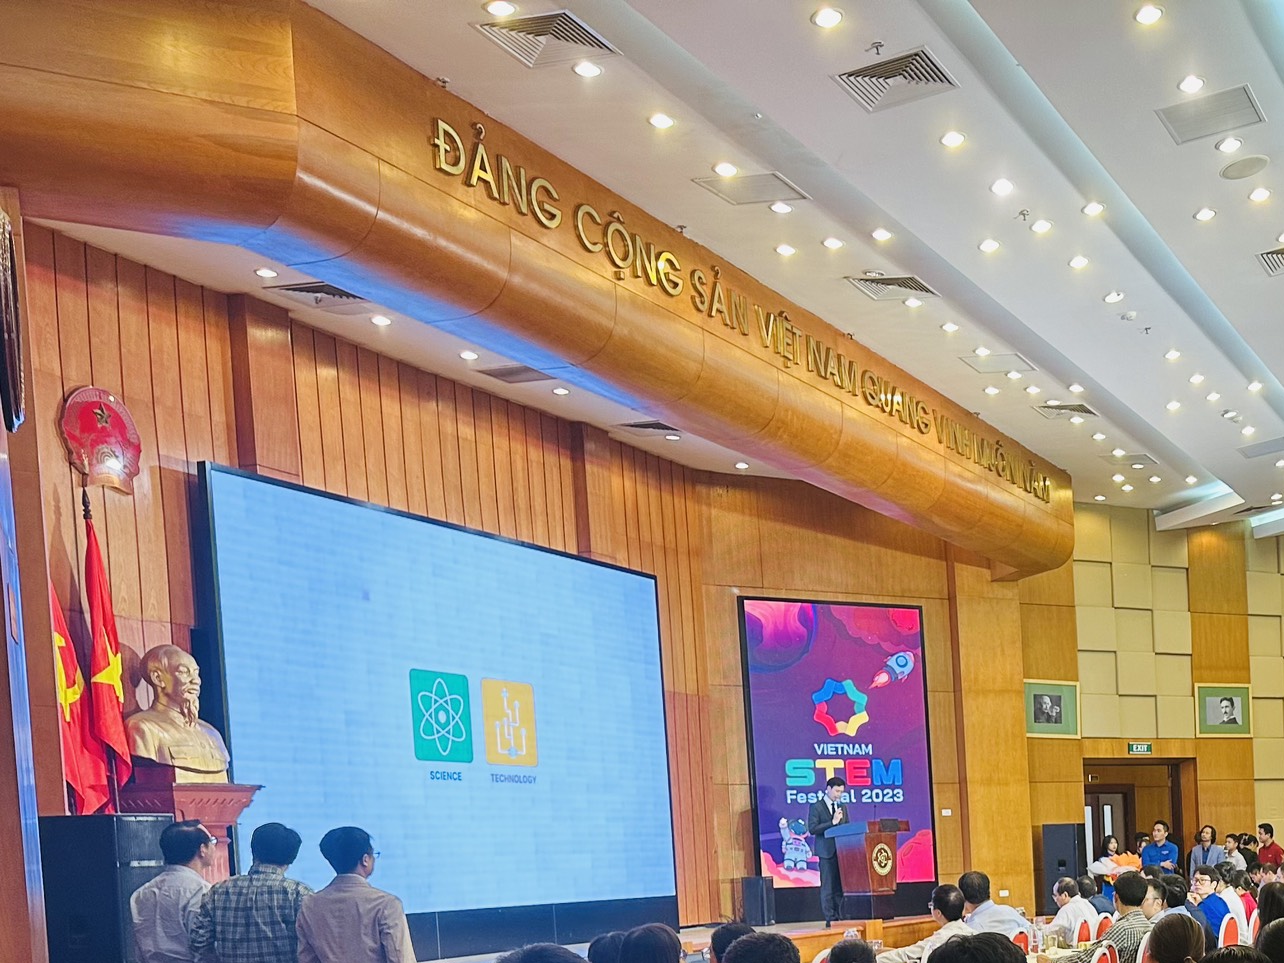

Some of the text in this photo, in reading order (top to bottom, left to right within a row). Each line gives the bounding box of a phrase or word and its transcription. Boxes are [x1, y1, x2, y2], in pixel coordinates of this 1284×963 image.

[431, 118, 562, 229] ĐẢNG
[574, 203, 684, 296] CỘNG
[690, 266, 749, 336] SẢN
[754, 304, 802, 369] VIỆT
[806, 335, 859, 397] NAM
[861, 369, 932, 435] QUANG
[932, 409, 972, 459] VINH
[814, 743, 872, 755] VIETNAM
[1133, 744, 1148, 752] EXIT
[430, 770, 462, 781] SCIENCE
[490, 773, 537, 784] TECHNOLOGY
[785, 759, 902, 786] STEM
[786, 789, 903, 804] Festal 2023
